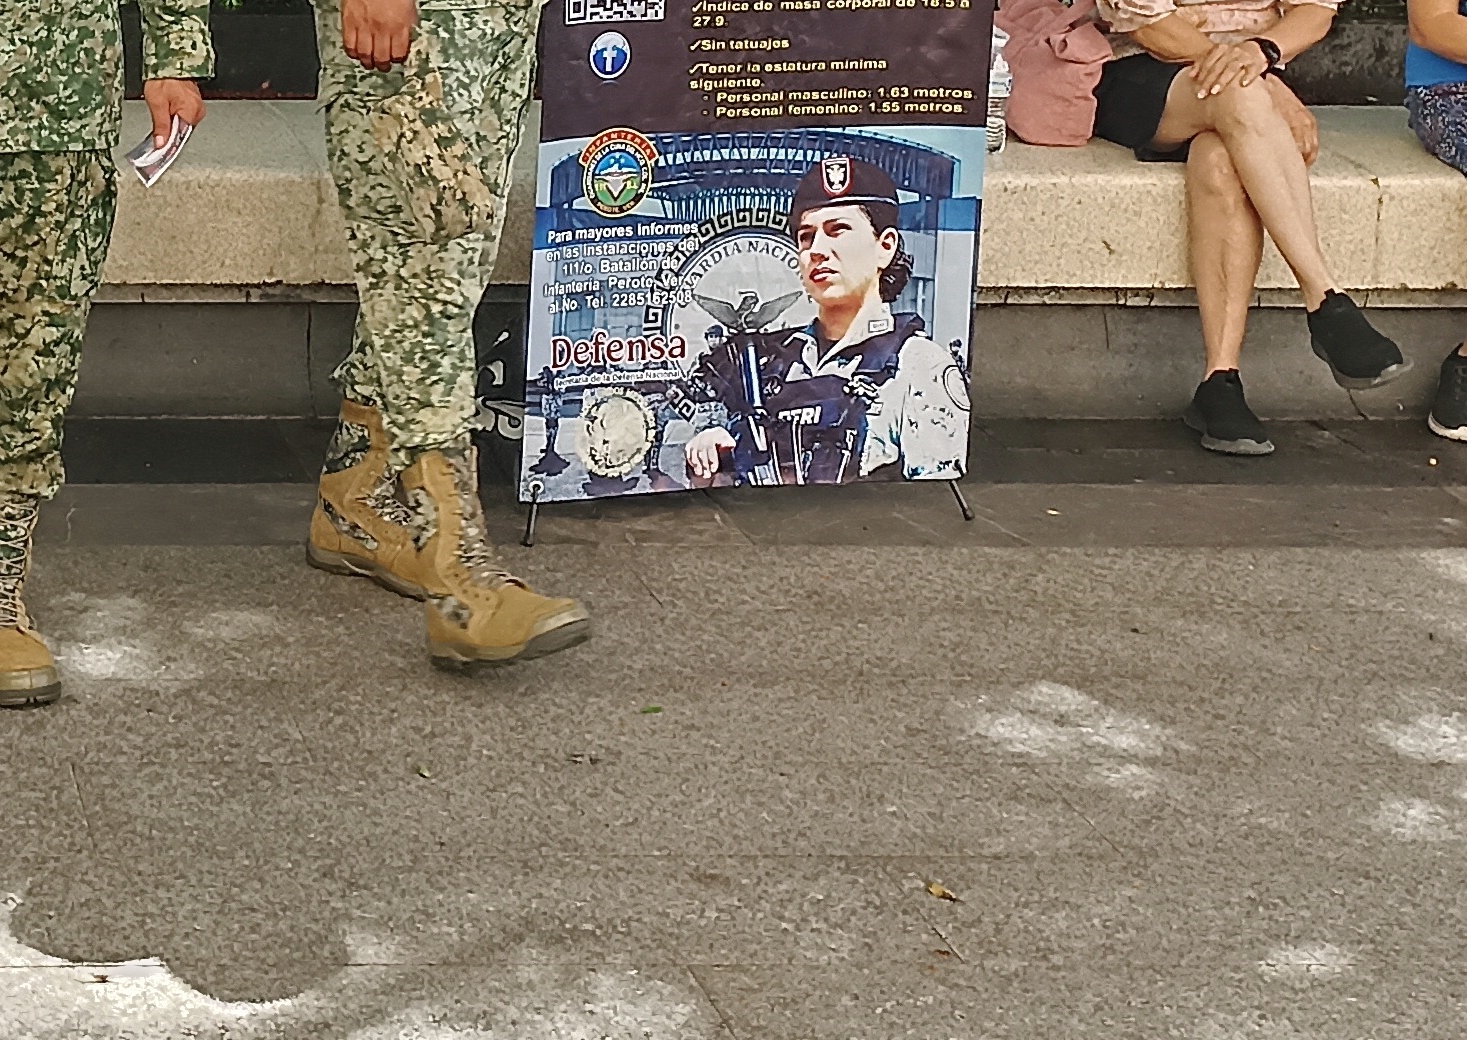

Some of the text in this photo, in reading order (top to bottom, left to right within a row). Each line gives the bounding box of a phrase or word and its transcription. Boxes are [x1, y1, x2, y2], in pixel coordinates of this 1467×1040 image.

[700, 38, 789, 51] Sin tatuajes
[716, 91, 783, 103] Personal
[788, 88, 872, 101] masculino:
[877, 87, 909, 99] 1.63
[715, 106, 783, 118] Personal
[788, 103, 863, 115] femenino:
[869, 102, 900, 113] 1.55
[547, 222, 699, 244] Para mayores informes
[546, 238, 699, 261] en las instalaciones del
[600, 257, 657, 273] Batallón
[661, 256, 678, 270] de
[549, 303, 558, 314] al
[586, 295, 608, 307] Tel.
[551, 331, 687, 369] Defensa
[603, 374, 610, 382] la
[613, 373, 644, 381] Defensa
[646, 371, 679, 380] Nacional
